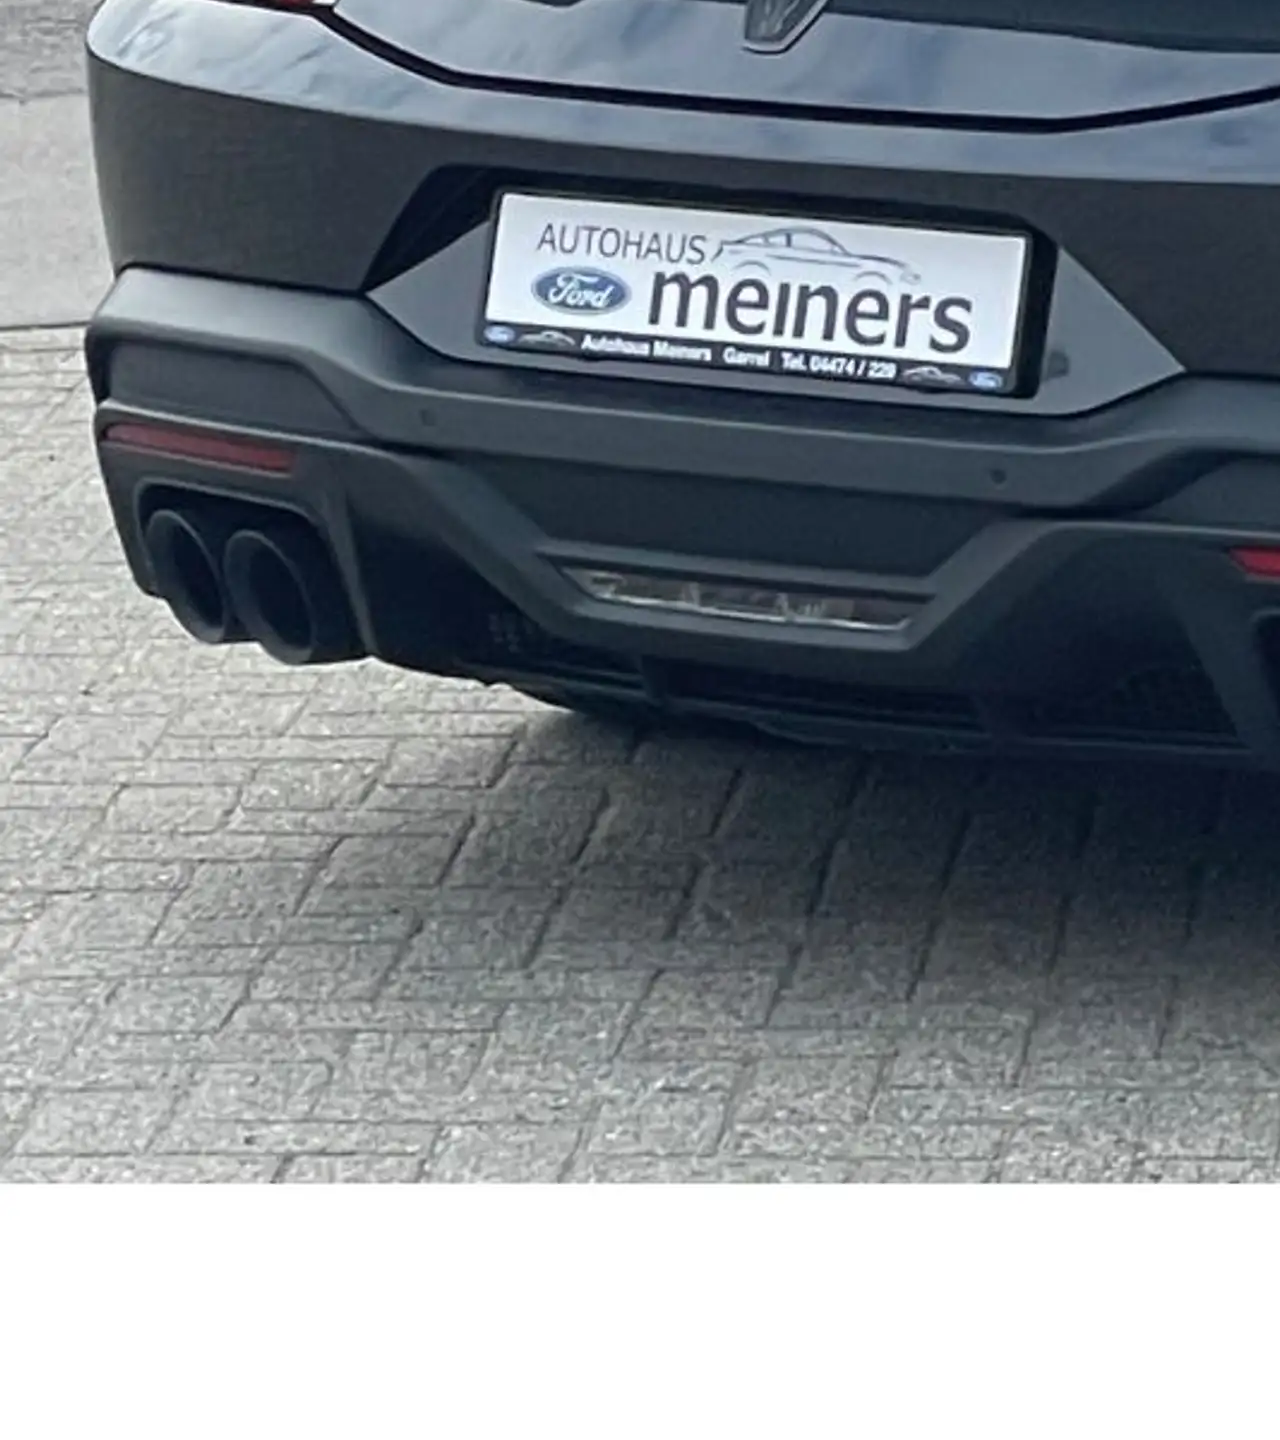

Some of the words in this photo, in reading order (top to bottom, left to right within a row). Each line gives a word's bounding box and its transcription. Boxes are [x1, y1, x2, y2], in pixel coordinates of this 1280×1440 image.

[537, 223, 707, 265] AUTOHAUS
[549, 271, 616, 309] Ford
[648, 270, 974, 354] meiners
[581, 333, 649, 356] Autohaus
